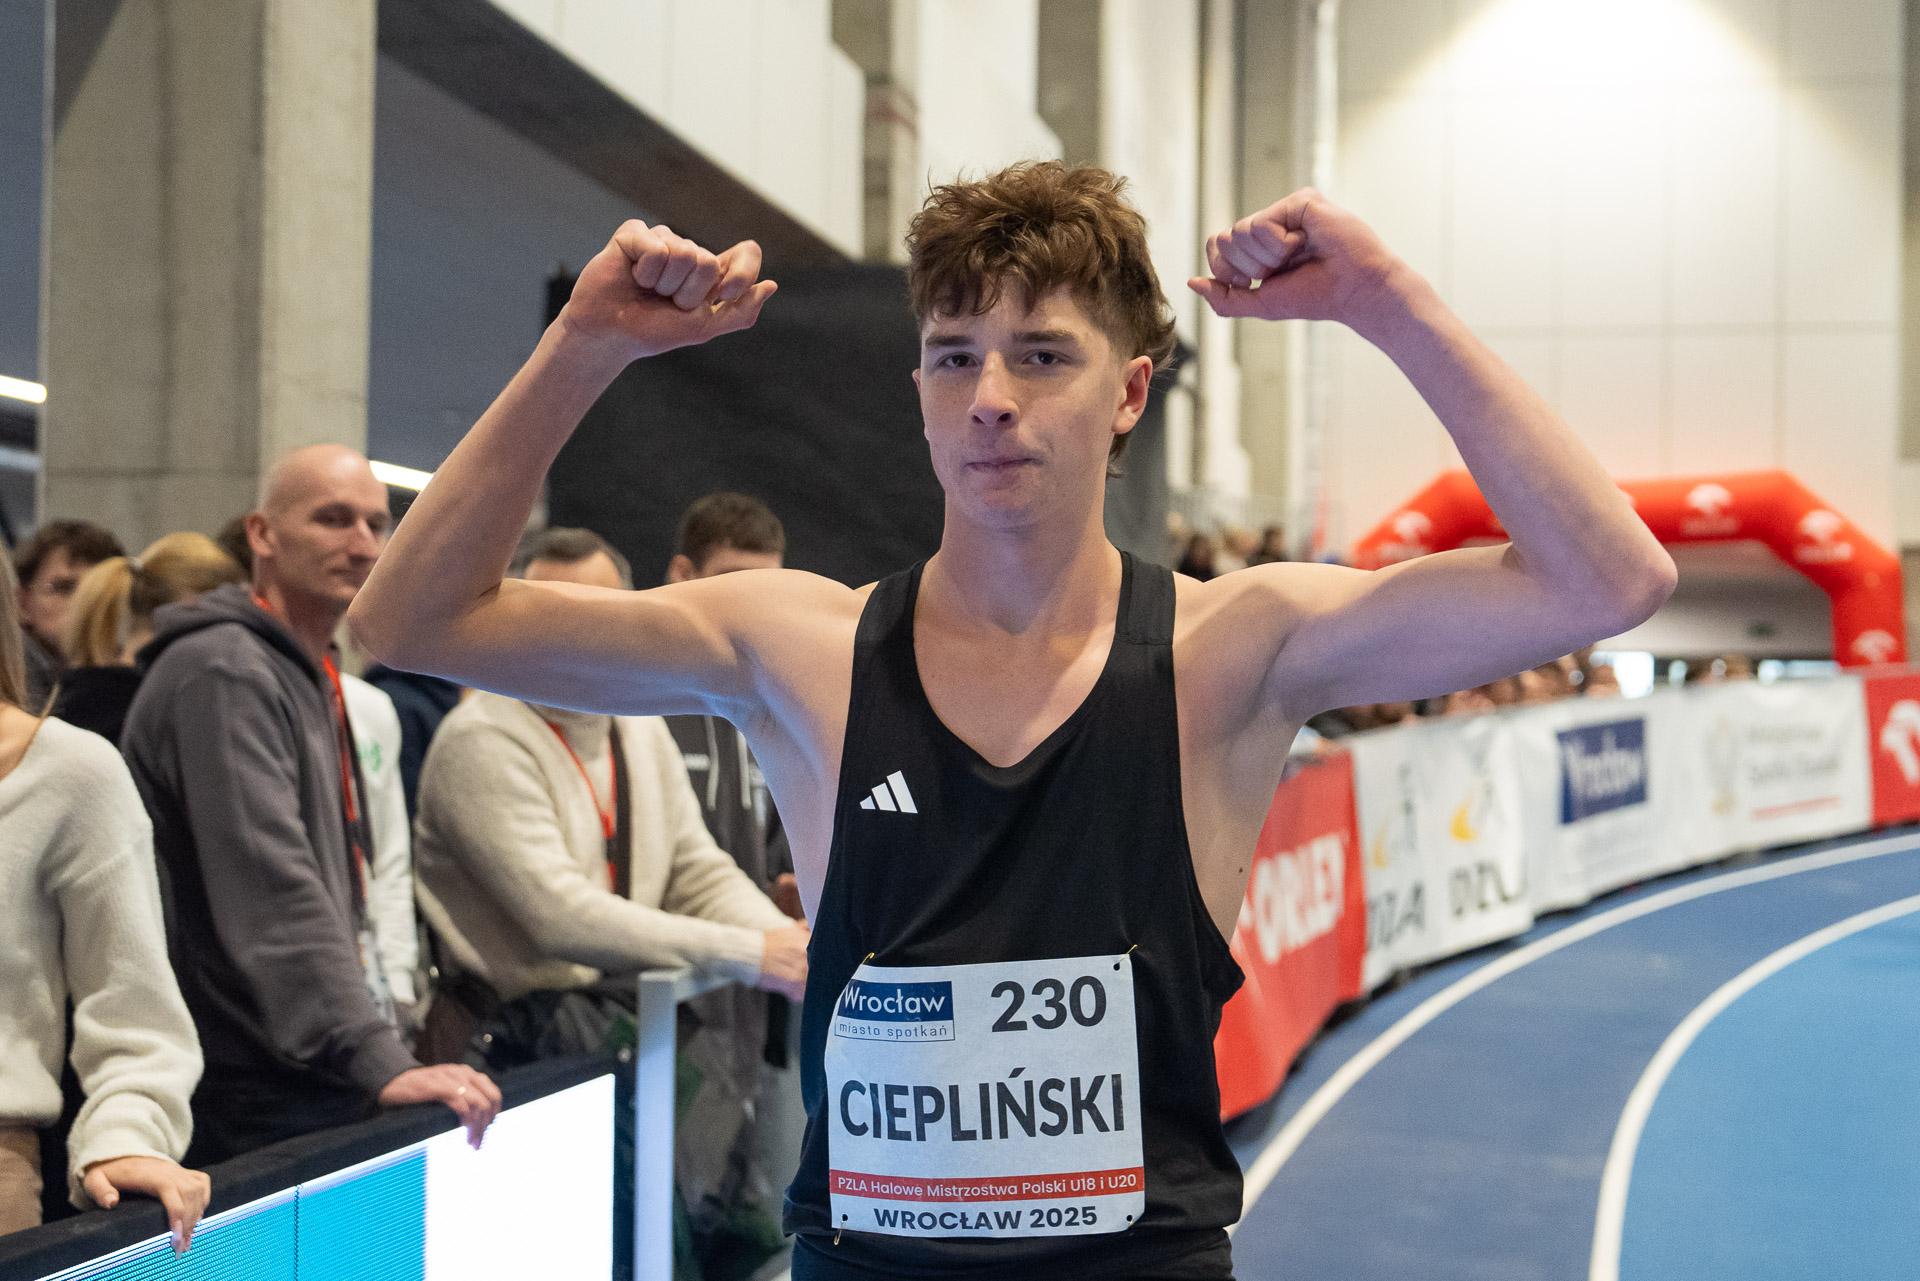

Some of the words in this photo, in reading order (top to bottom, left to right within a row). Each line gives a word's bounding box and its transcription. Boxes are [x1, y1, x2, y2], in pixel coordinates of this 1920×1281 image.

[844, 986, 946, 1014] Wrocław
[990, 975, 1107, 1033] 230
[839, 1022, 880, 1036] miasto
[887, 1025, 947, 1039] spotkań
[839, 1067, 1125, 1142] CIEPLIŃSKI
[838, 1177, 868, 1191] PZLA
[871, 1181, 923, 1196] Halowe
[927, 1183, 1018, 1197] Mistrzostwa
[1022, 1179, 1066, 1194] Polski
[1070, 1177, 1096, 1191] U18
[1100, 1176, 1104, 1189] i
[1108, 1174, 1137, 1189] U20
[873, 1208, 1022, 1230] WROCŁAW
[1029, 1206, 1098, 1228] 2025
